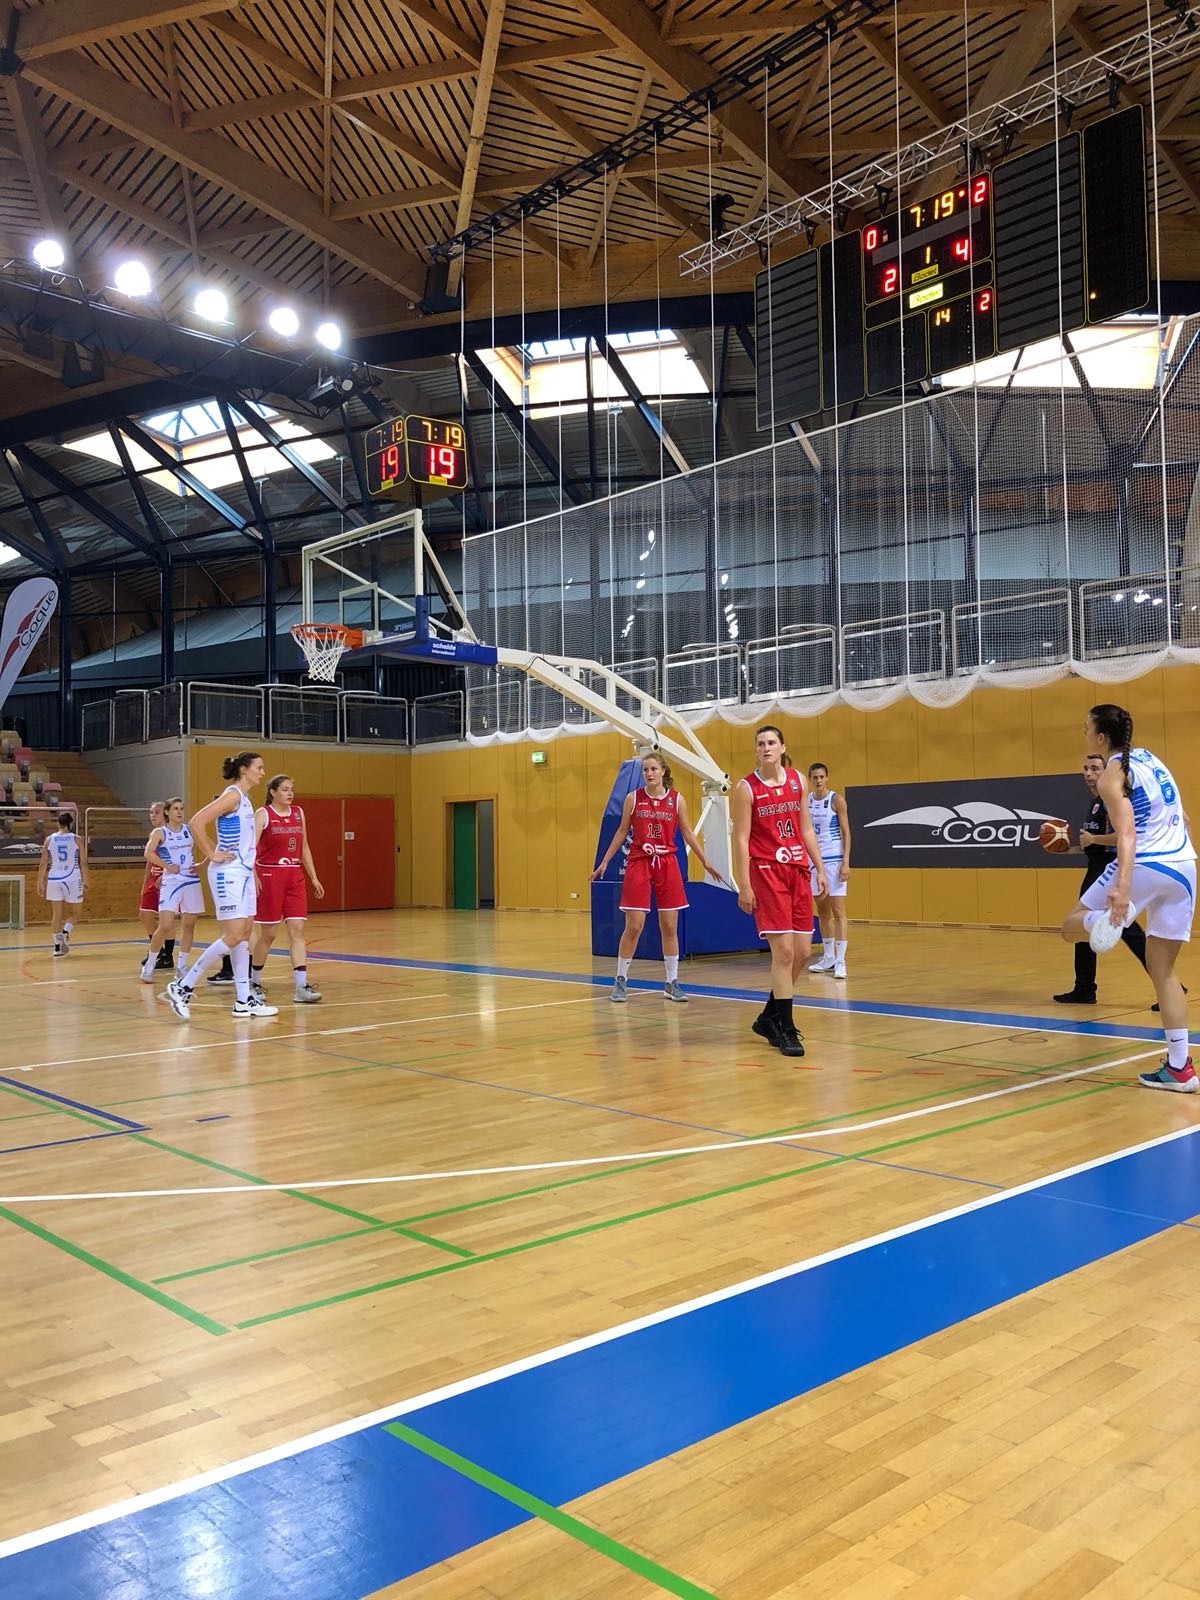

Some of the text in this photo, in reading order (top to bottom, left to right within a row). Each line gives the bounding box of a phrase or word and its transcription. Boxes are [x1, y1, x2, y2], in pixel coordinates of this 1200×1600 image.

[866, 228, 877, 250] 0
[955, 239, 969, 260] 4
[884, 268, 897, 293] 2
[980, 292, 990, 312] 2
[936, 309, 950, 326] 14
[376, 420, 403, 447] 7:19
[422, 421, 462, 447] 7:19
[382, 446, 398, 480] 19
[430, 447, 454, 479] 19
[21, 590, 57, 646] Coque
[432, 643, 457, 651] schelde
[1152, 766, 1176, 806] 6
[637, 809, 673, 821] BELGIUM
[647, 823, 661, 839] 12
[776, 819, 795, 839] 14
[943, 820, 1041, 847] Coqu
[57, 845, 68, 861] 5
[288, 837, 297, 852] 9
